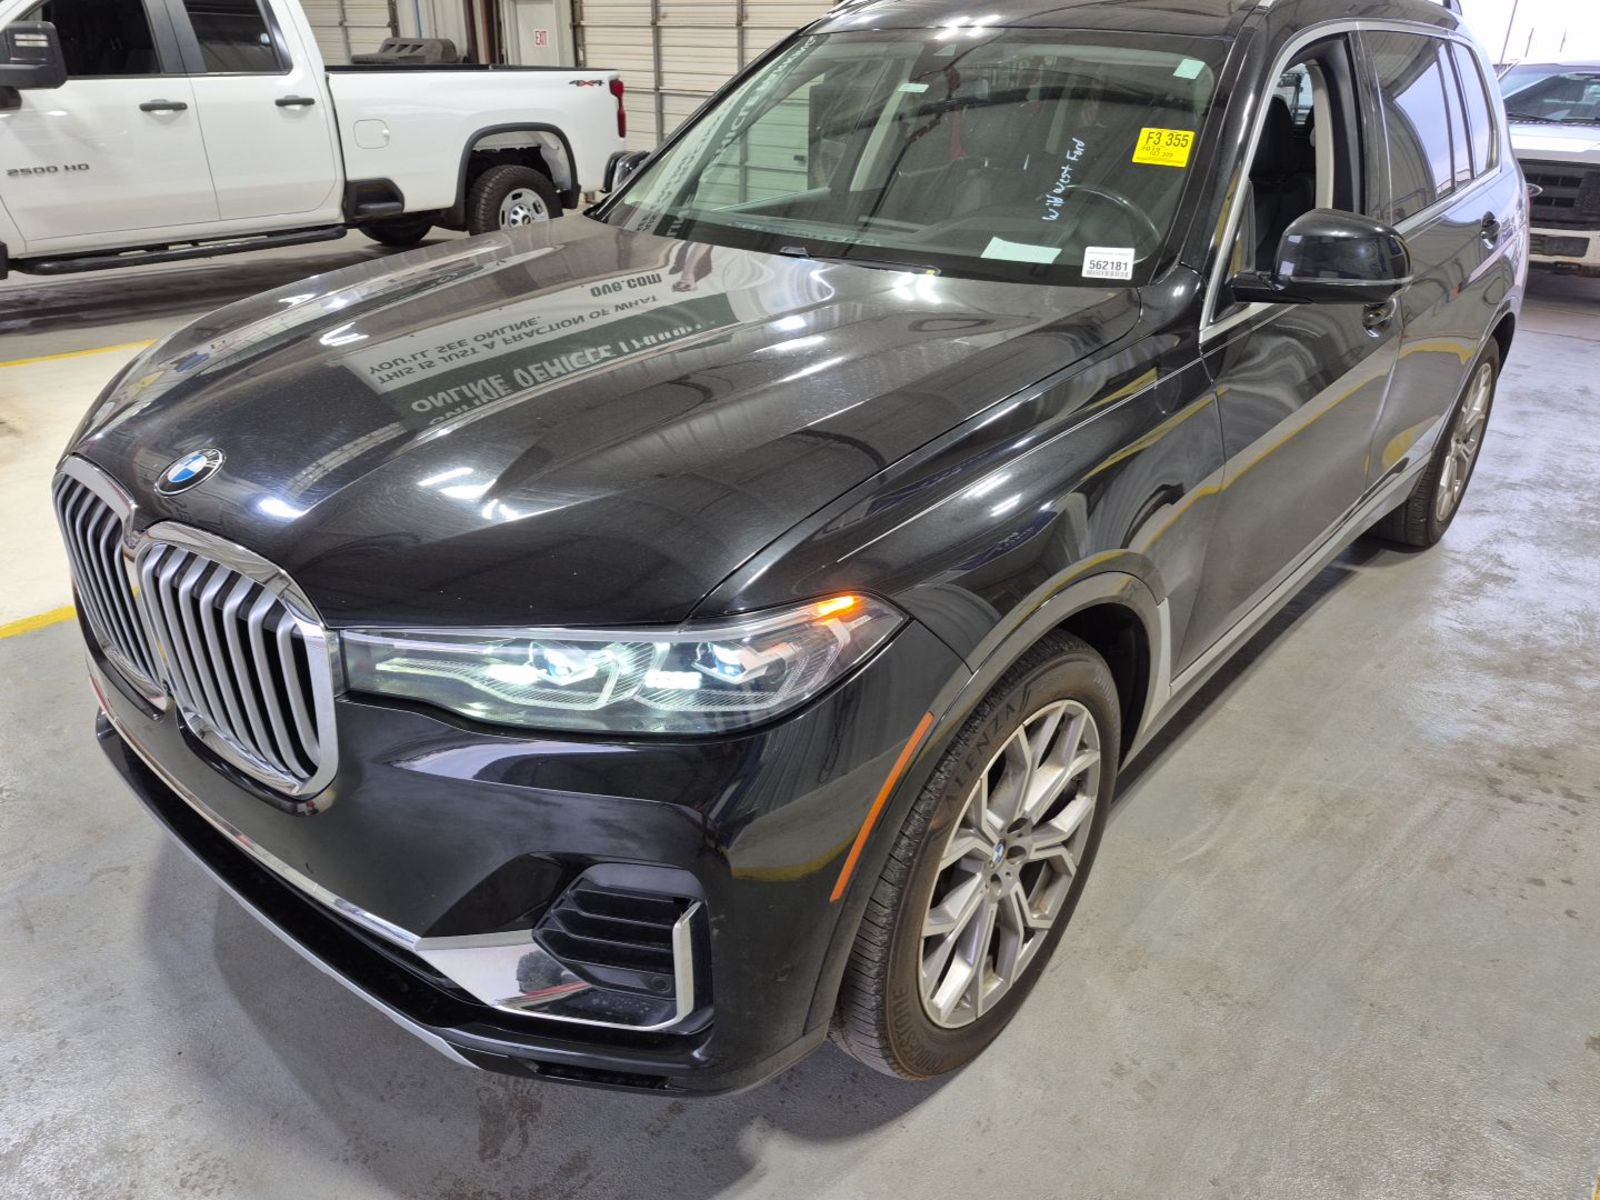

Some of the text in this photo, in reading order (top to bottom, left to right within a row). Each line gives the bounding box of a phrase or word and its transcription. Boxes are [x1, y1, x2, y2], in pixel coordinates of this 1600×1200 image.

[1146, 131, 1162, 146] F3
[1165, 132, 1190, 148] 355
[7, 163, 90, 177] 2500 HD
[1089, 259, 1128, 271] 562181
